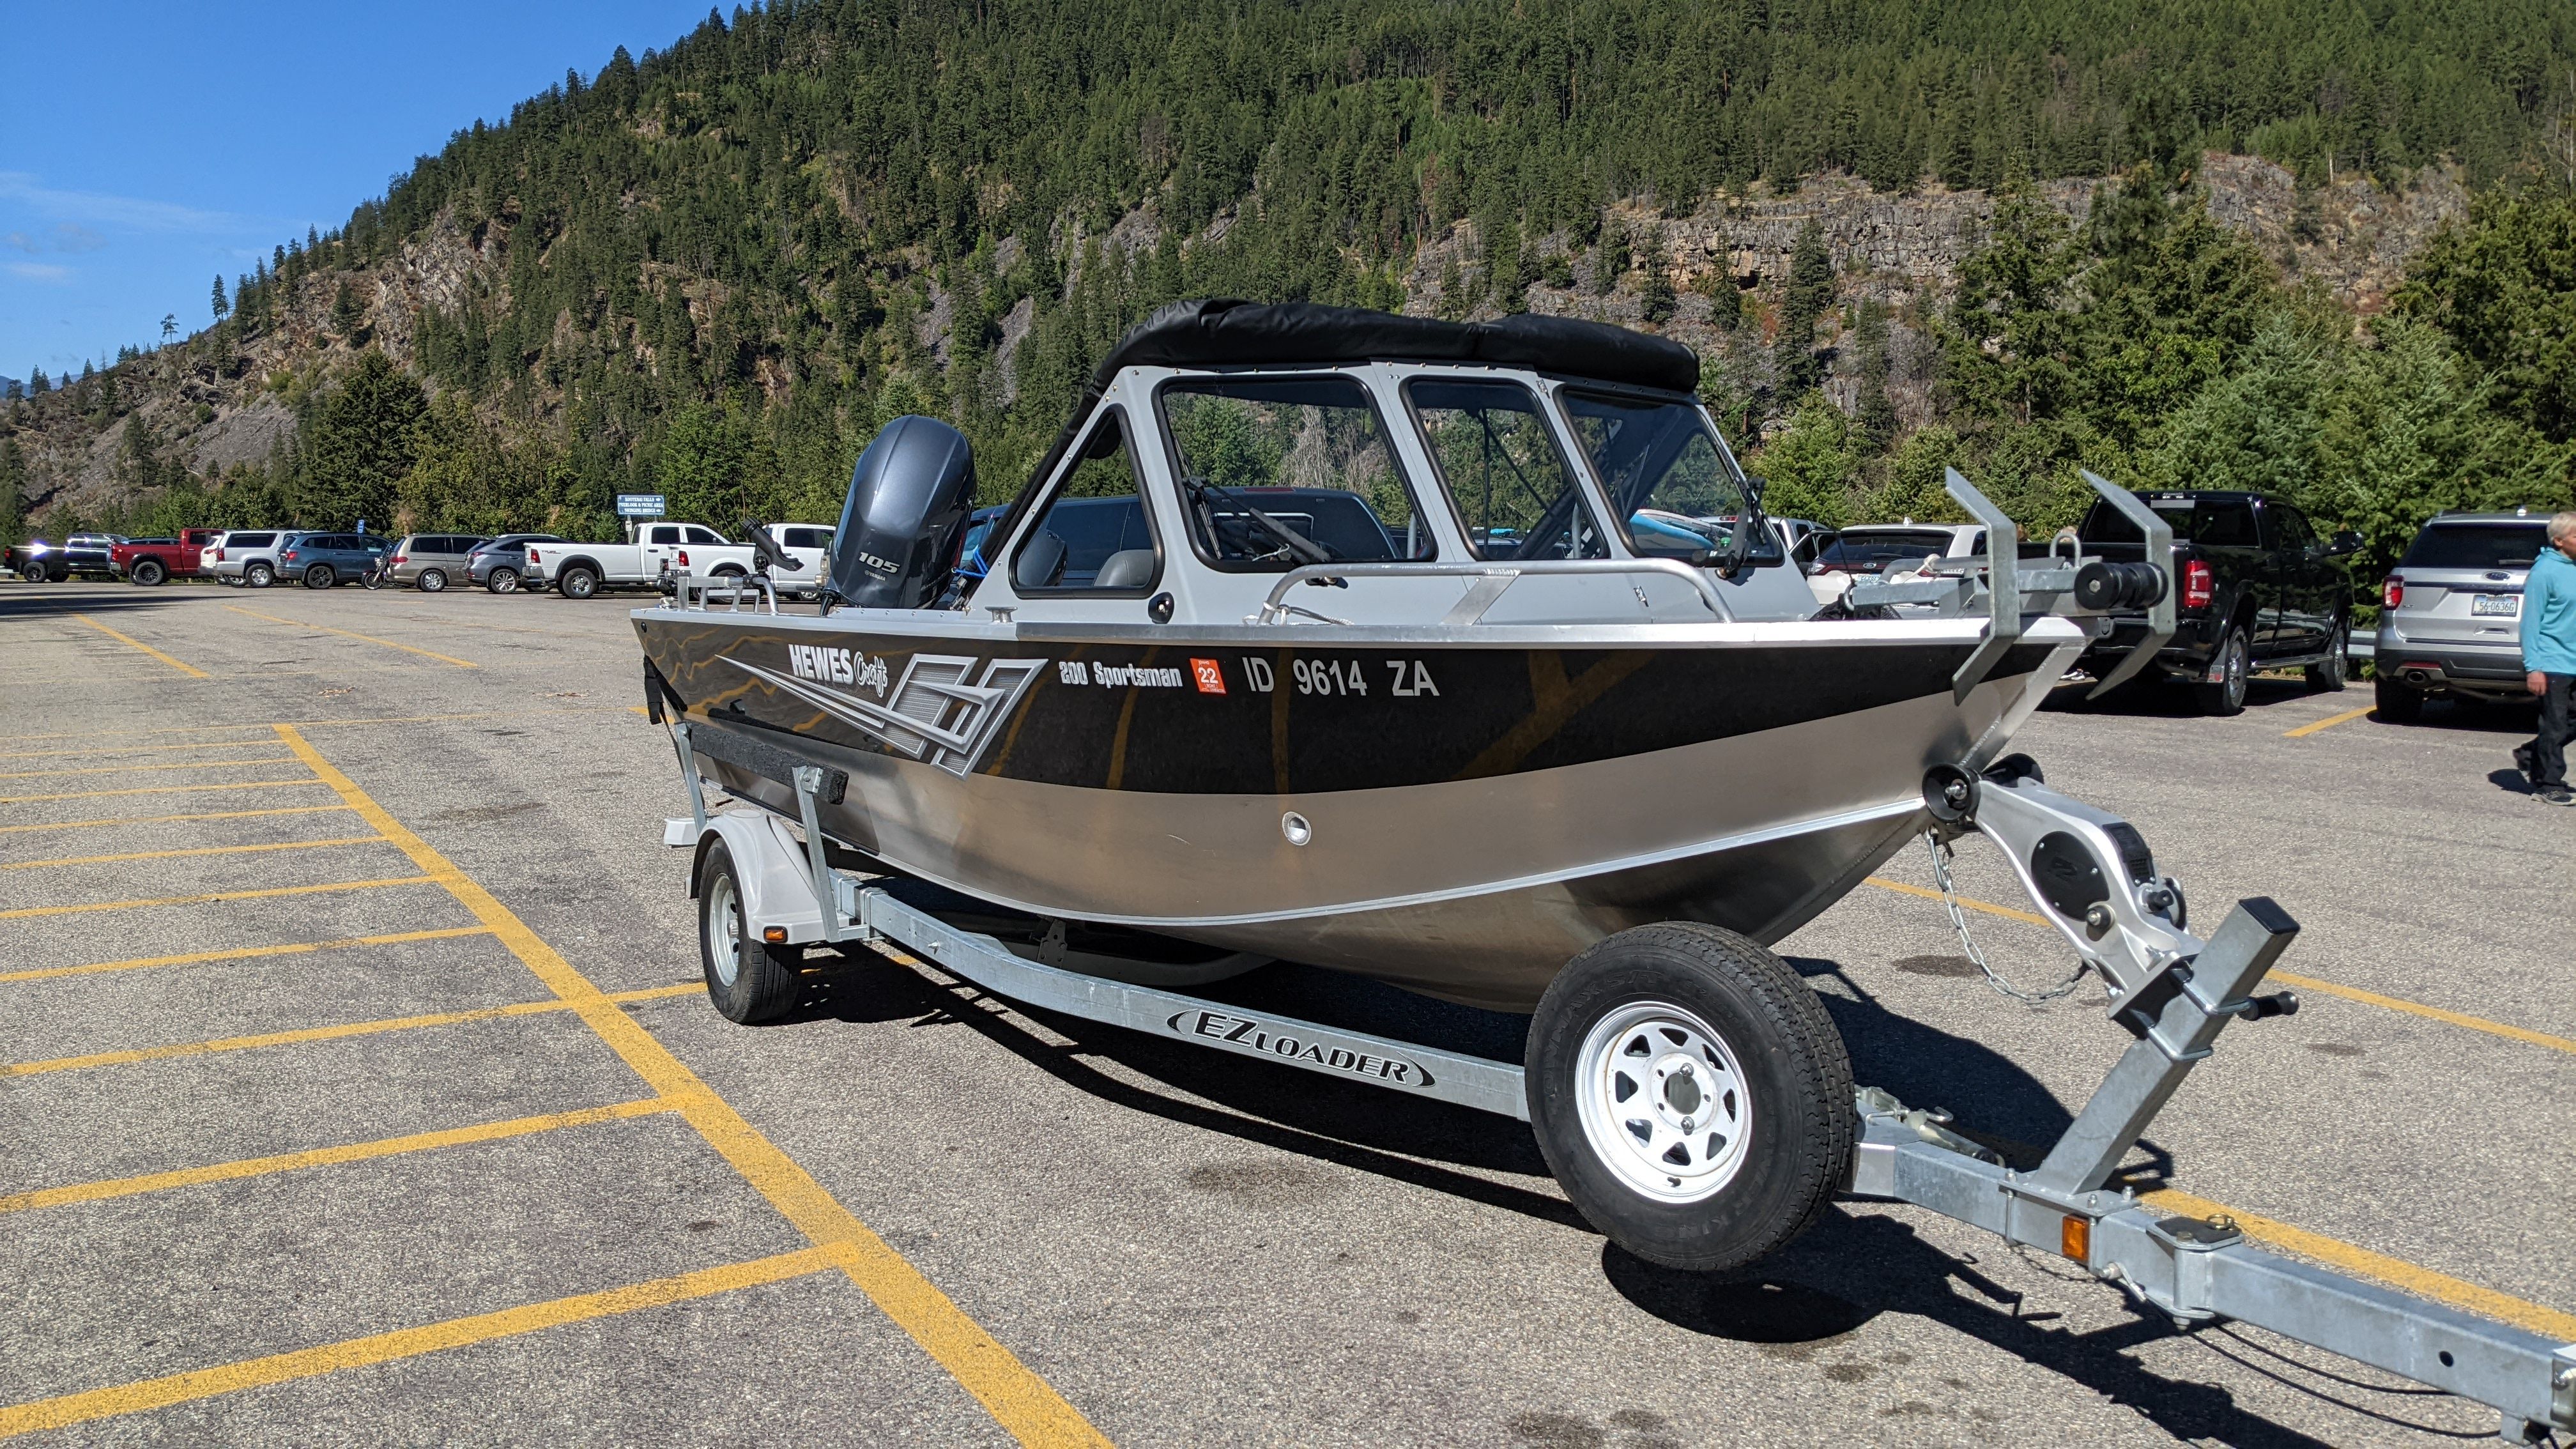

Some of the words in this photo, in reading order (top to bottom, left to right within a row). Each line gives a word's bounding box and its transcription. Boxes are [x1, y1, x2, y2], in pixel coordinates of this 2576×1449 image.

[859, 551, 900, 574] 105
[869, 571, 886, 581] YAMAHA
[788, 643, 854, 684] HEWES
[854, 650, 888, 698] Craft
[1059, 661, 1088, 686] 200
[1092, 661, 1183, 689] Sportsman
[1198, 667, 1219, 684] 22
[1241, 657, 1275, 692] ID
[1292, 659, 1368, 696] 9614
[1386, 660, 1441, 696] ZA
